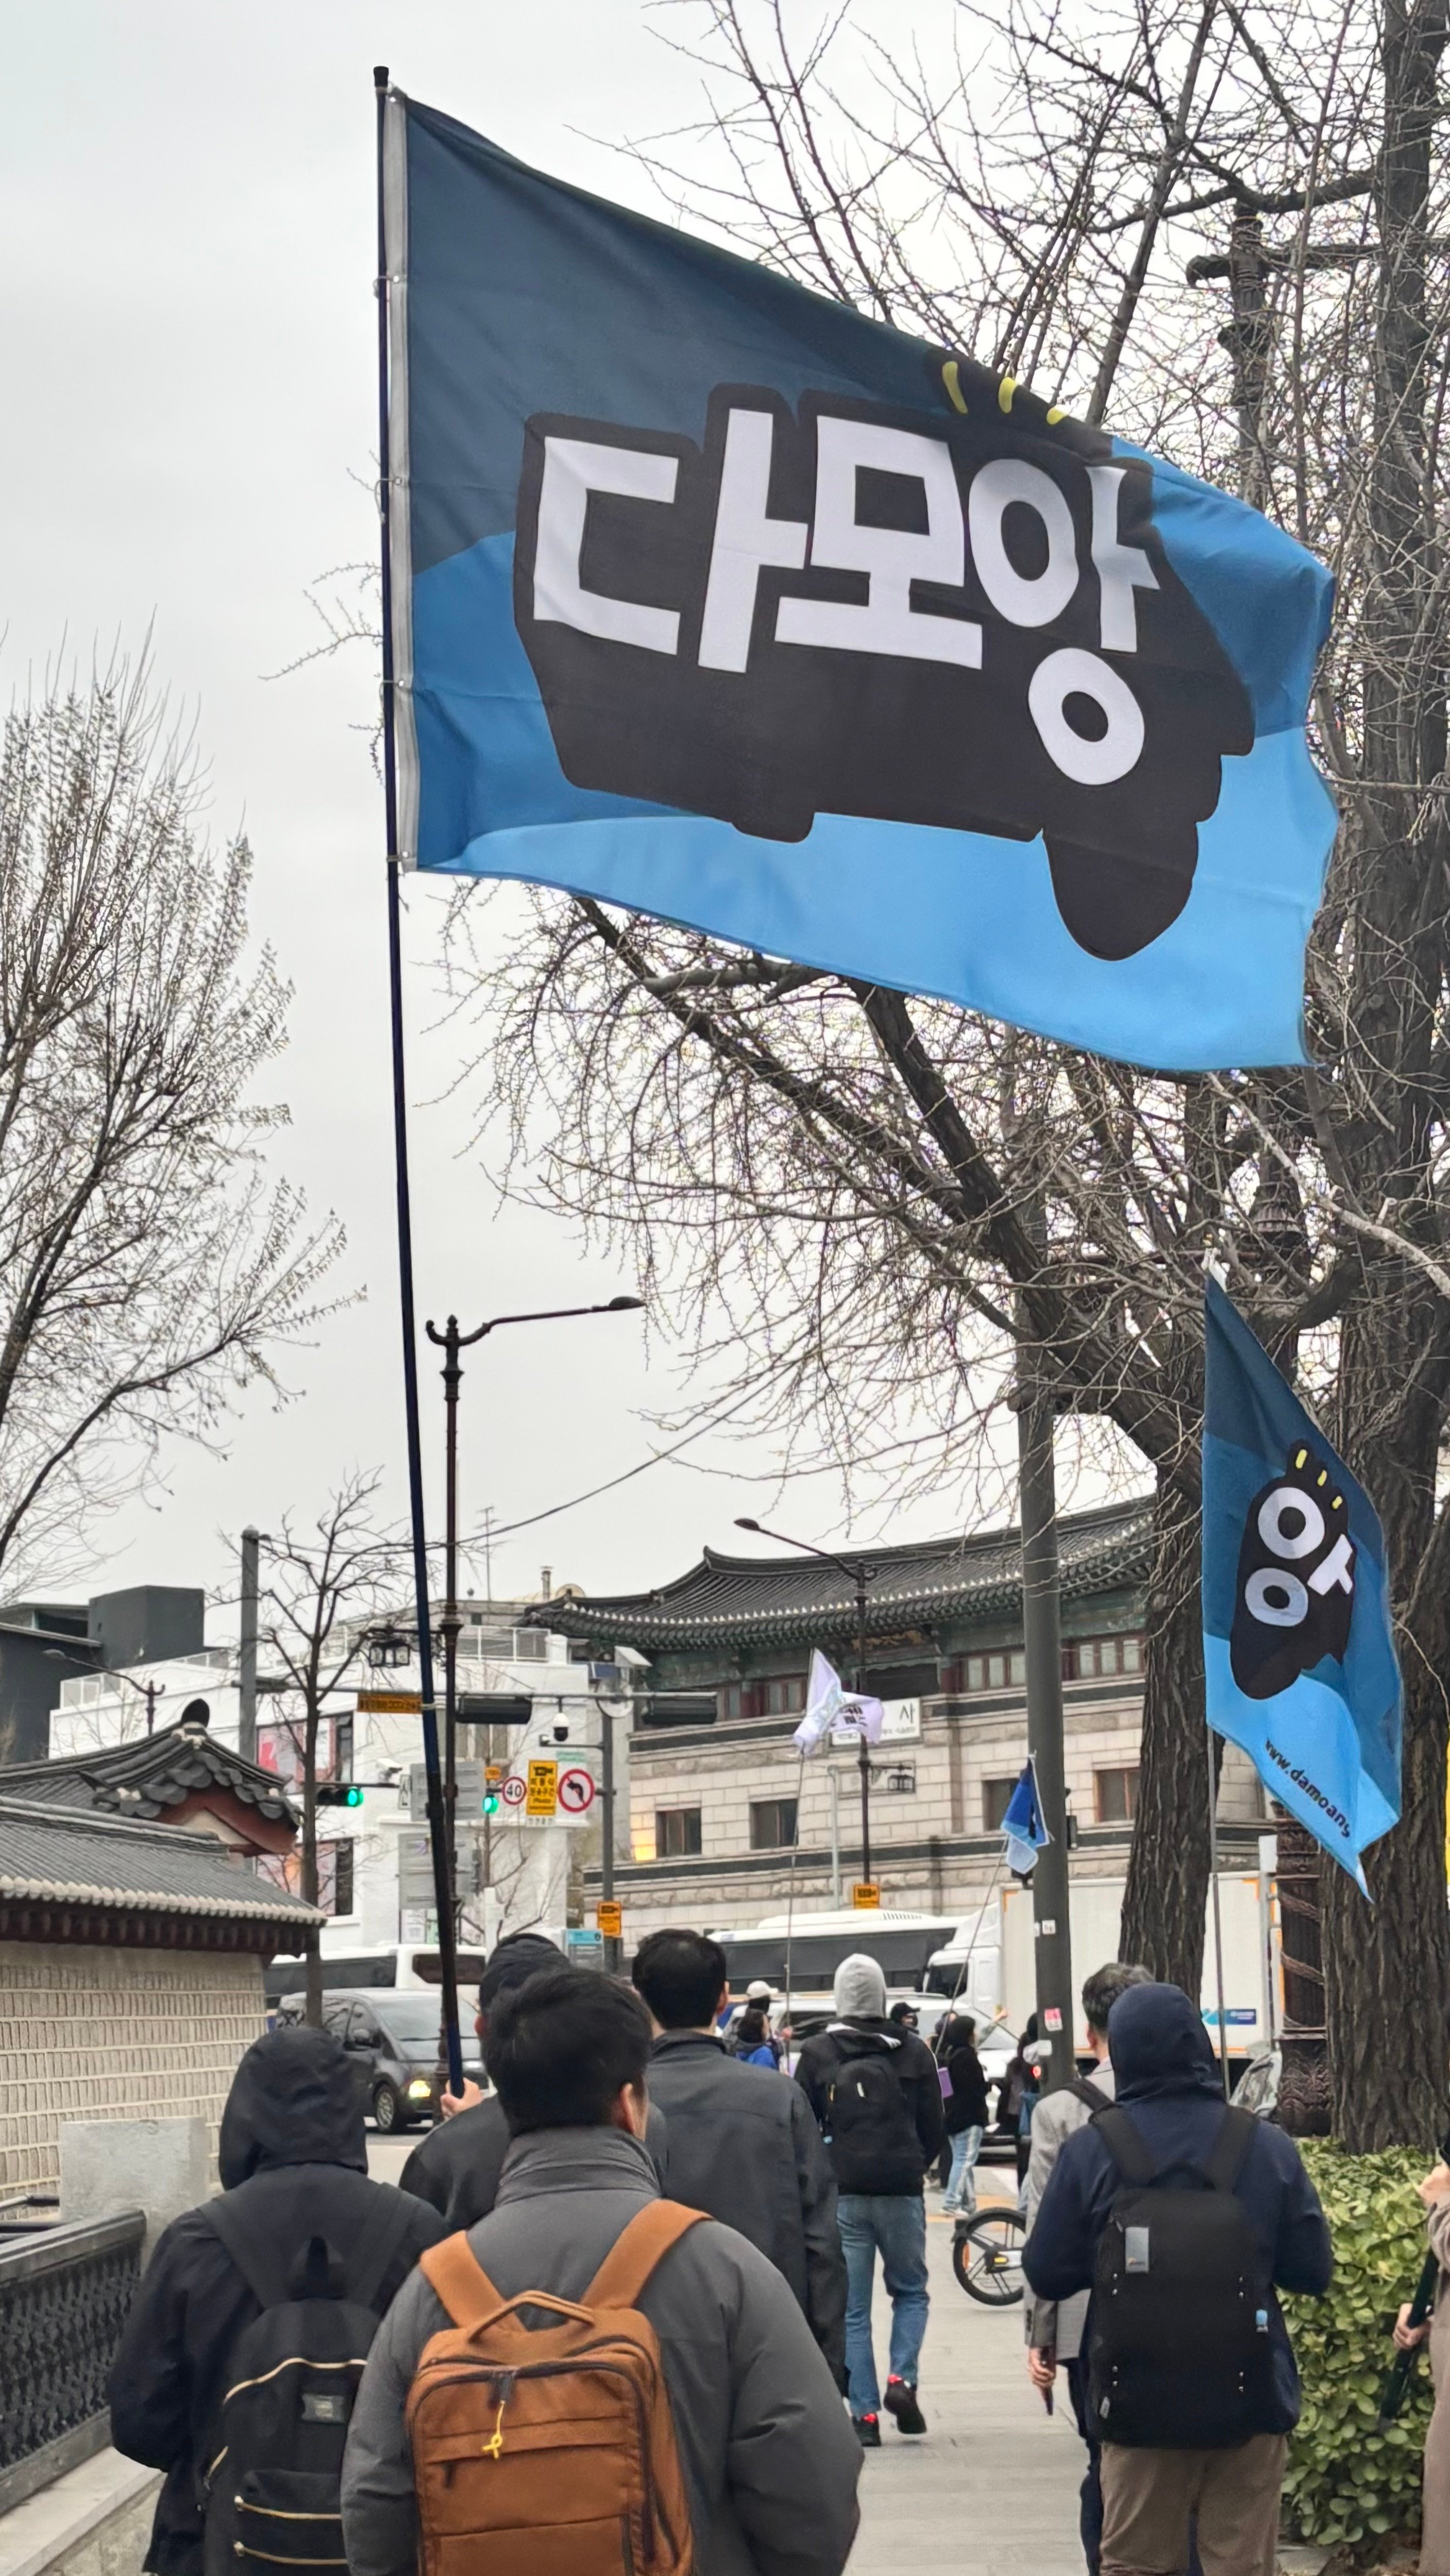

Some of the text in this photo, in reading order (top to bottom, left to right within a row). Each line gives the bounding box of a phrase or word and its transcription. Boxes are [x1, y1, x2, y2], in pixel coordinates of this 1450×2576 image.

[533, 408, 1159, 785] 다모앙
[1245, 1487, 1353, 1627] 앙
[507, 1784, 522, 1798] 40
